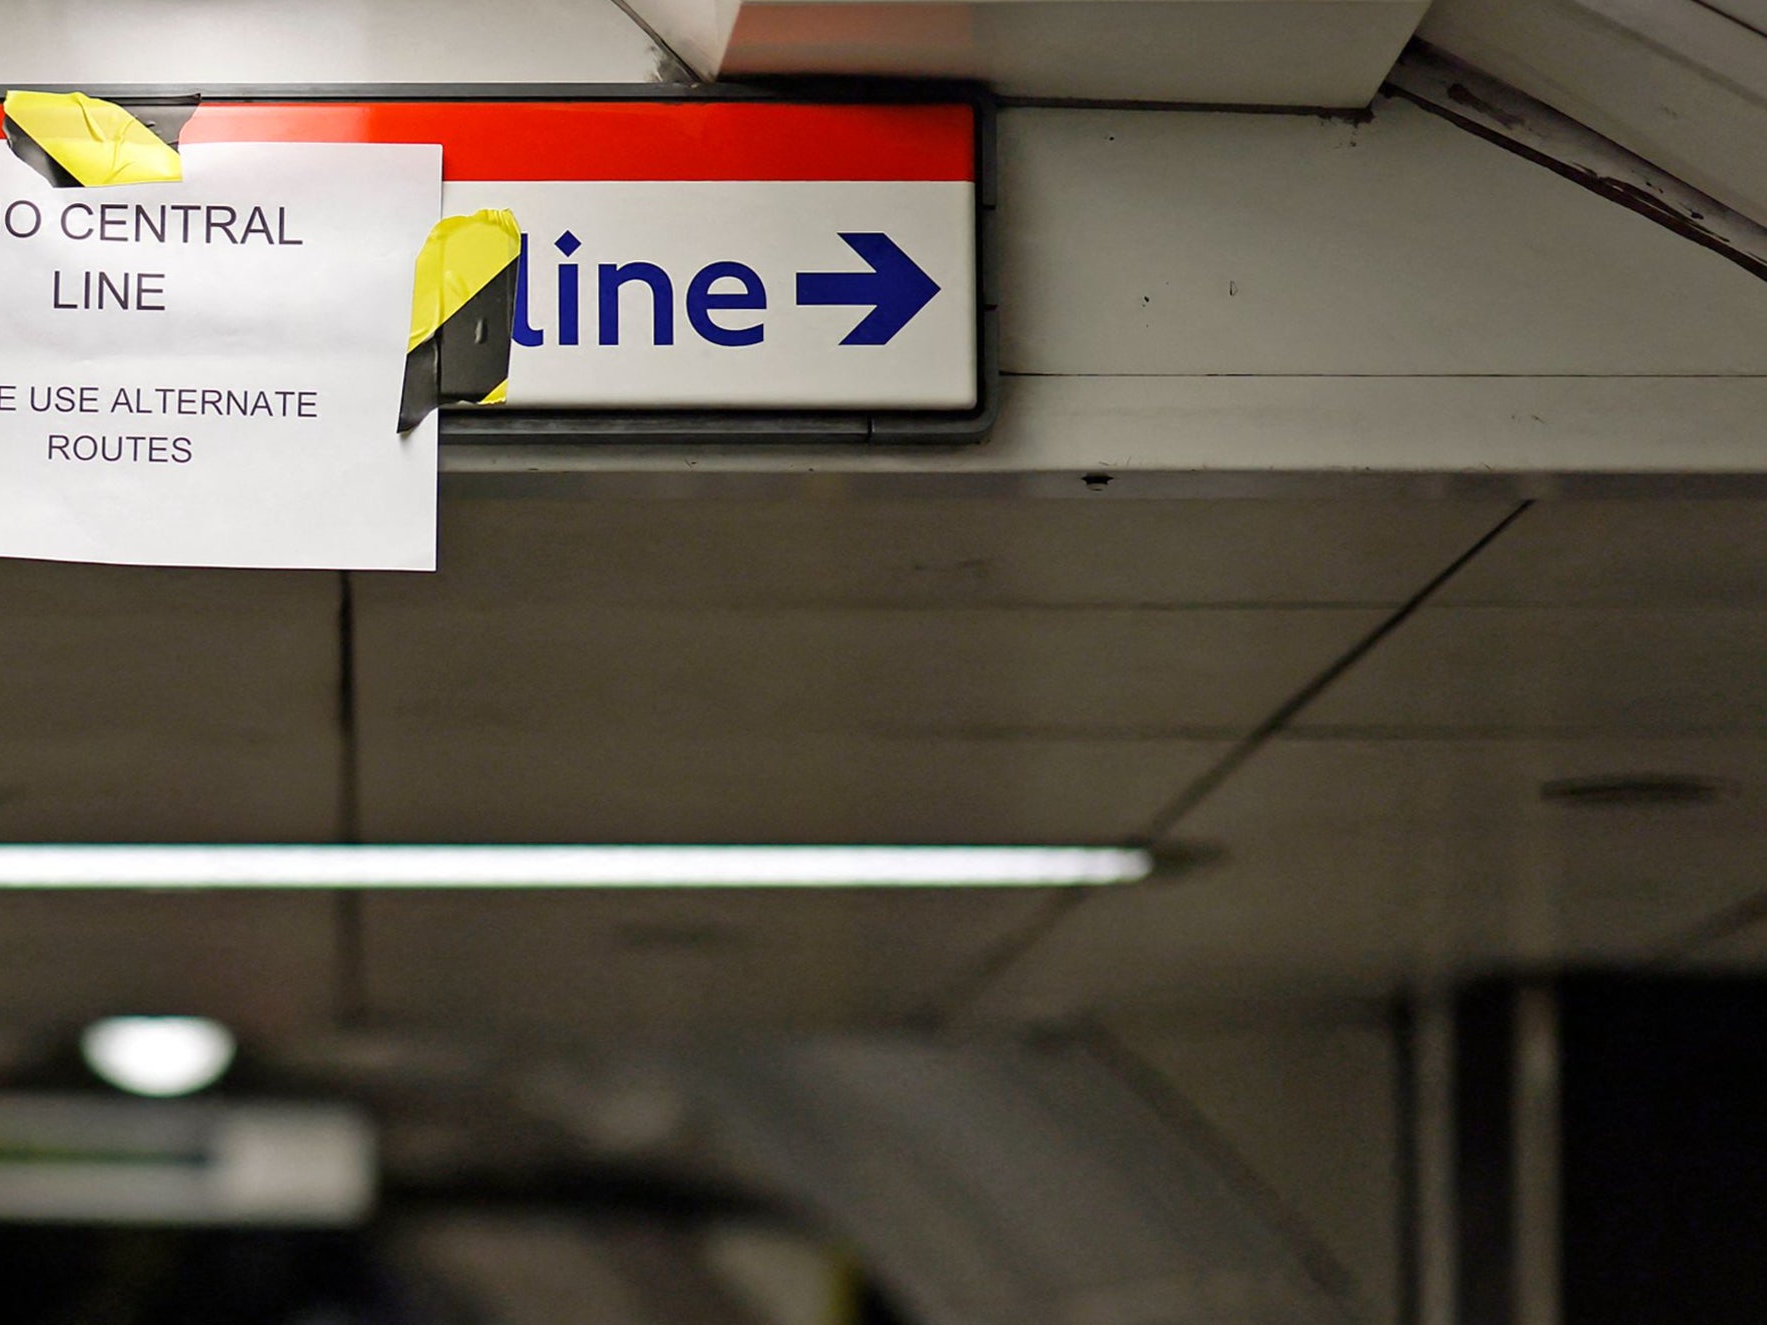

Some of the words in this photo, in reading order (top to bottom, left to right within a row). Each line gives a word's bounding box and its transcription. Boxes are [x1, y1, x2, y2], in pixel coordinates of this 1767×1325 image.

[60, 202, 303, 245] CENTRAL
[53, 270, 165, 311] LINE
[30, 386, 99, 413] USE
[110, 387, 317, 418] ALTERNATE
[48, 434, 192, 463] ROUTES
